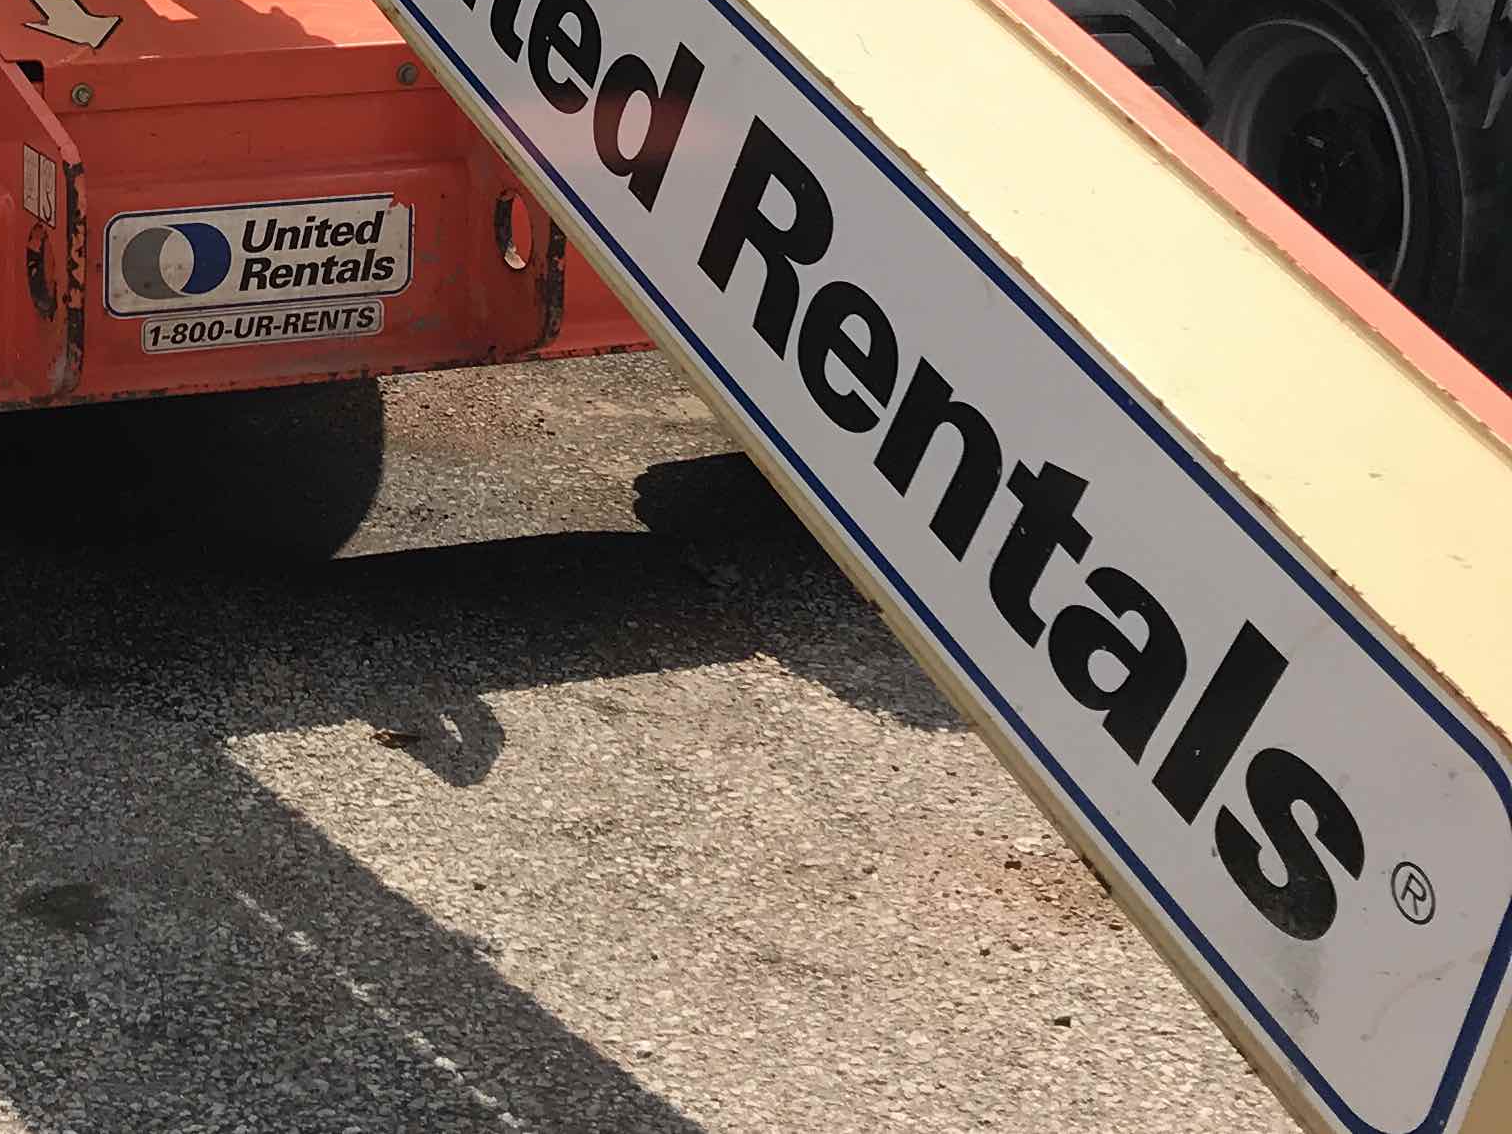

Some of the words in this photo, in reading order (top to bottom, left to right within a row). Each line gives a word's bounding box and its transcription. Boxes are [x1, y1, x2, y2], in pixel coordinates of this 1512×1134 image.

[242, 210, 386, 254] United
[239, 248, 396, 292] Rentals
[149, 306, 377, 347] 1-800-UR-RENTS
[698, 114, 1365, 941] Rentals
